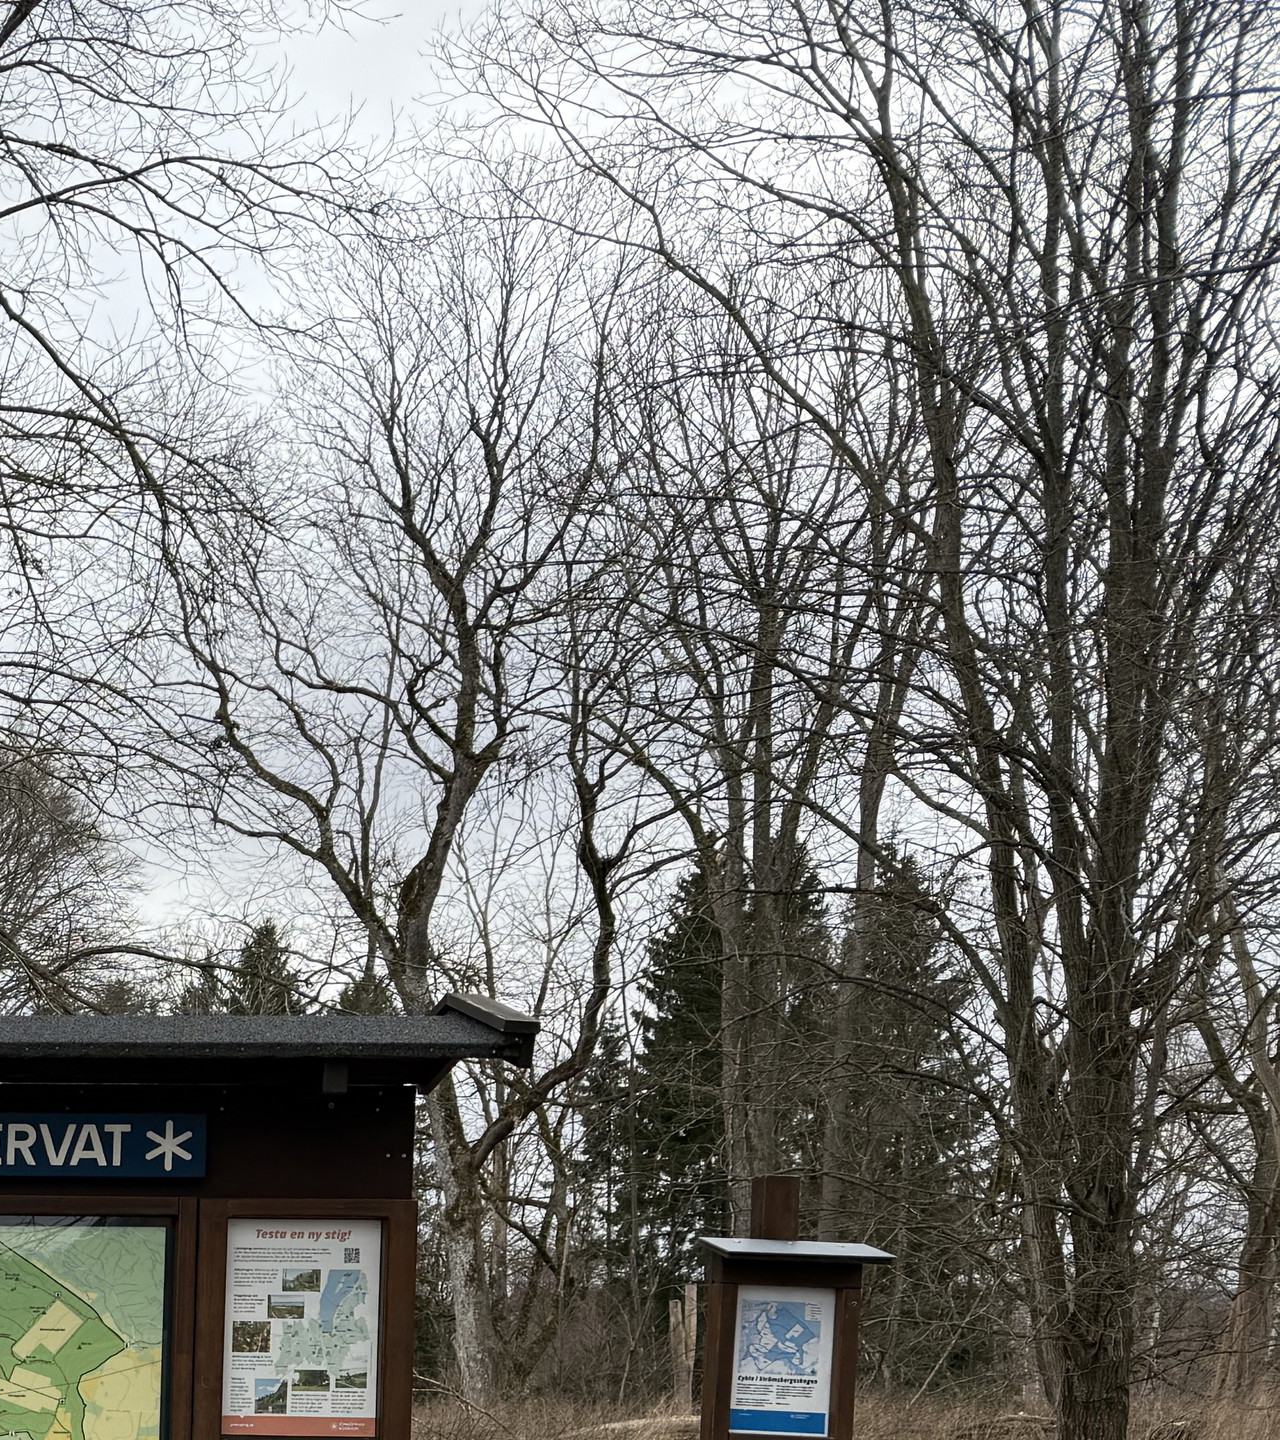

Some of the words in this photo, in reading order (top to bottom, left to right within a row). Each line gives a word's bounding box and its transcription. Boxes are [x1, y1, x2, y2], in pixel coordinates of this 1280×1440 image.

[256, 1229, 287, 1239] Testa
[290, 1231, 304, 1239] en
[308, 1232, 322, 1242] ny
[325, 1230, 352, 1242] stig!
